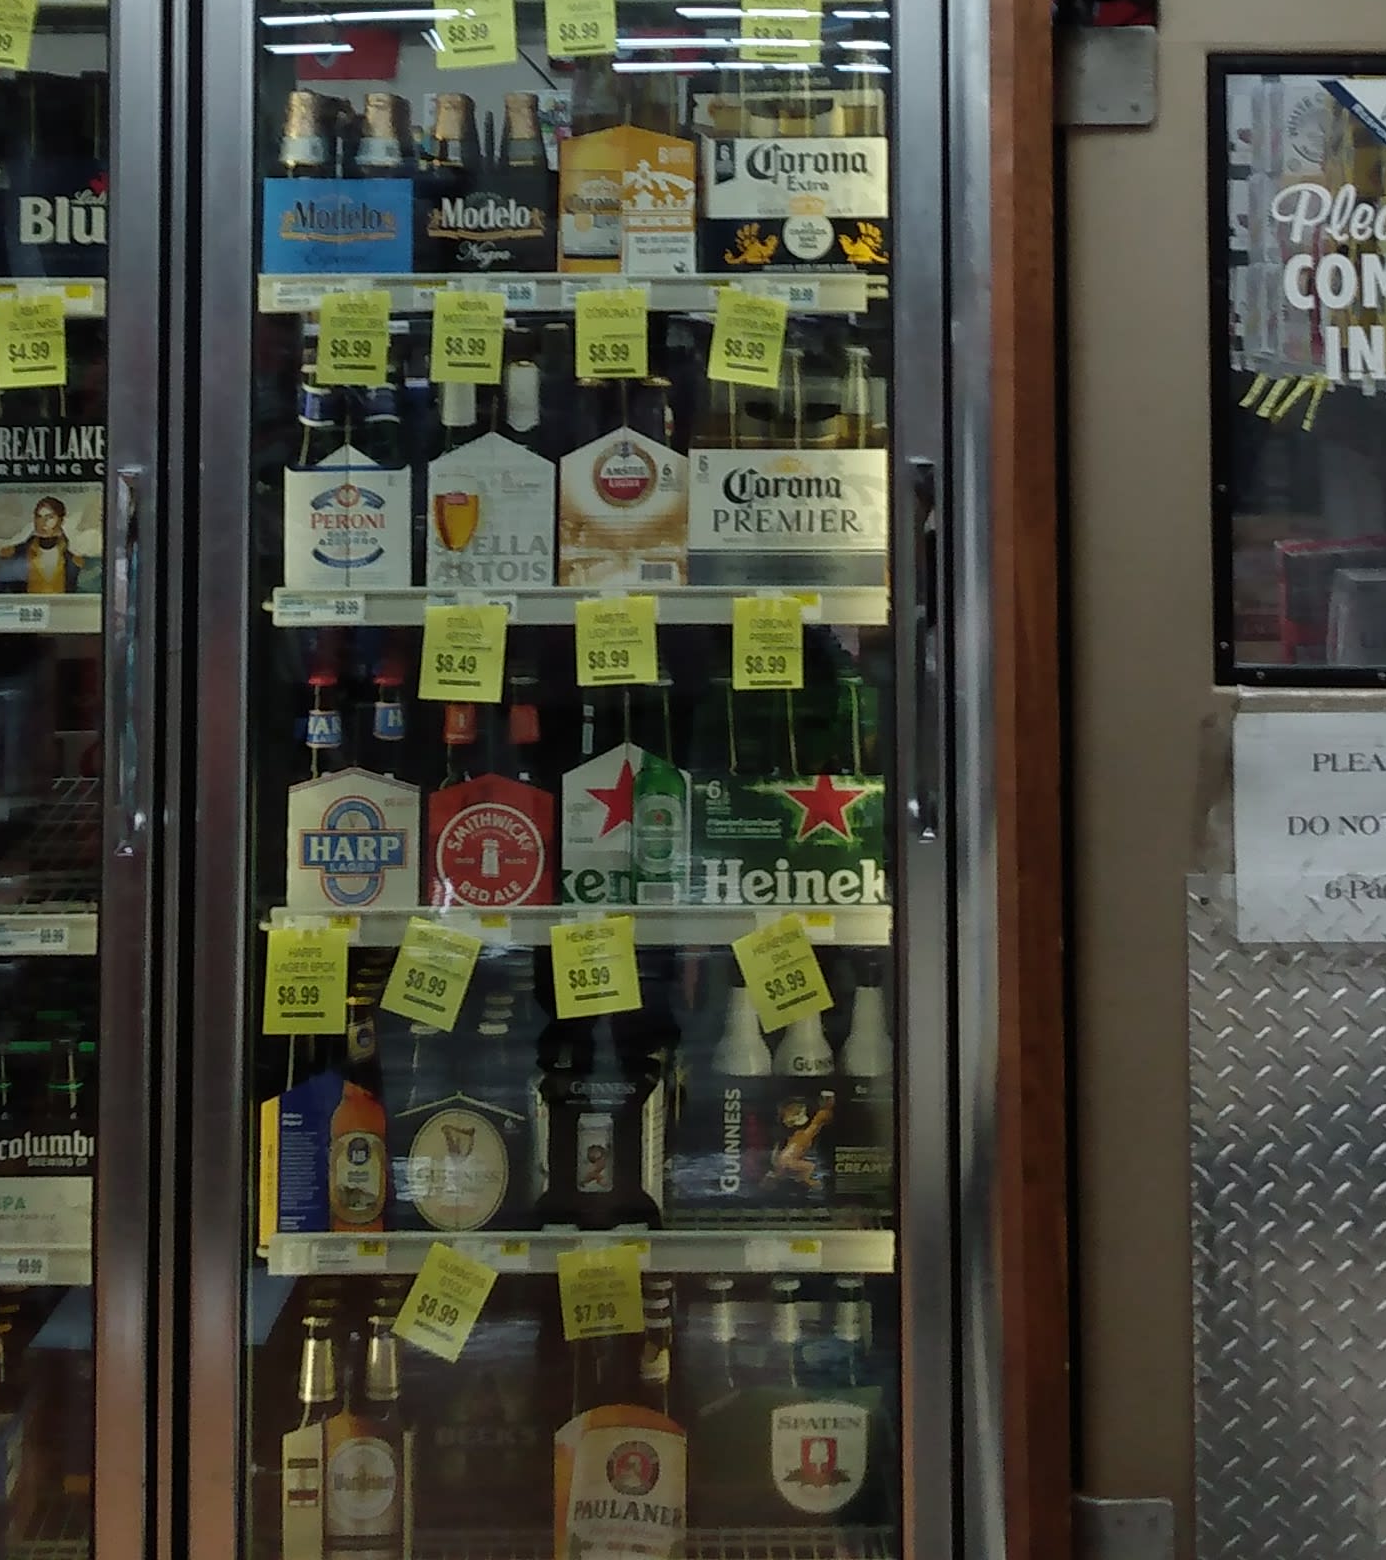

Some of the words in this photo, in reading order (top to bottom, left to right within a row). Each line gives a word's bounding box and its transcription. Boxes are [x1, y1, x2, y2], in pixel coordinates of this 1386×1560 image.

[447, 22, 490, 43] $8.99
[558, 22, 600, 42] $8.99
[745, 143, 868, 184] Corona
[787, 175, 830, 192] Extra
[18, 196, 106, 245] Blu
[292, 198, 382, 231] Modelo
[439, 197, 531, 228] Modelo
[7, 341, 50, 363] $4.99
[330, 338, 372, 358] $8.99
[444, 337, 487, 357] $8.99
[588, 342, 630, 363] $8.99
[723, 337, 766, 361] $8.99
[721, 466, 842, 506] Corona
[309, 511, 387, 532] PERONI
[712, 507, 861, 535] PREMIER
[432, 560, 549, 585] ARTOIS
[588, 650, 630, 669] $8.99
[744, 655, 787, 673] $8.99
[706, 780, 722, 800] 6
[1288, 815, 1330, 836] DO
[309, 836, 401, 862] HARP
[459, 879, 491, 903] RED
[494, 880, 522, 903] ALE
[702, 857, 885, 904] Heinek
[403, 966, 448, 999] $8.99
[567, 965, 611, 990] $8.99
[763, 968, 809, 1000] $8.99
[276, 985, 321, 1007] $8.99
[568, 1079, 637, 1096] GUINNESS
[718, 1086, 743, 1195] GUINNESS
[417, 1293, 460, 1327] $8.99
[776, 1414, 863, 1433] SPATEN
[572, 1498, 685, 1529] PAULANER
